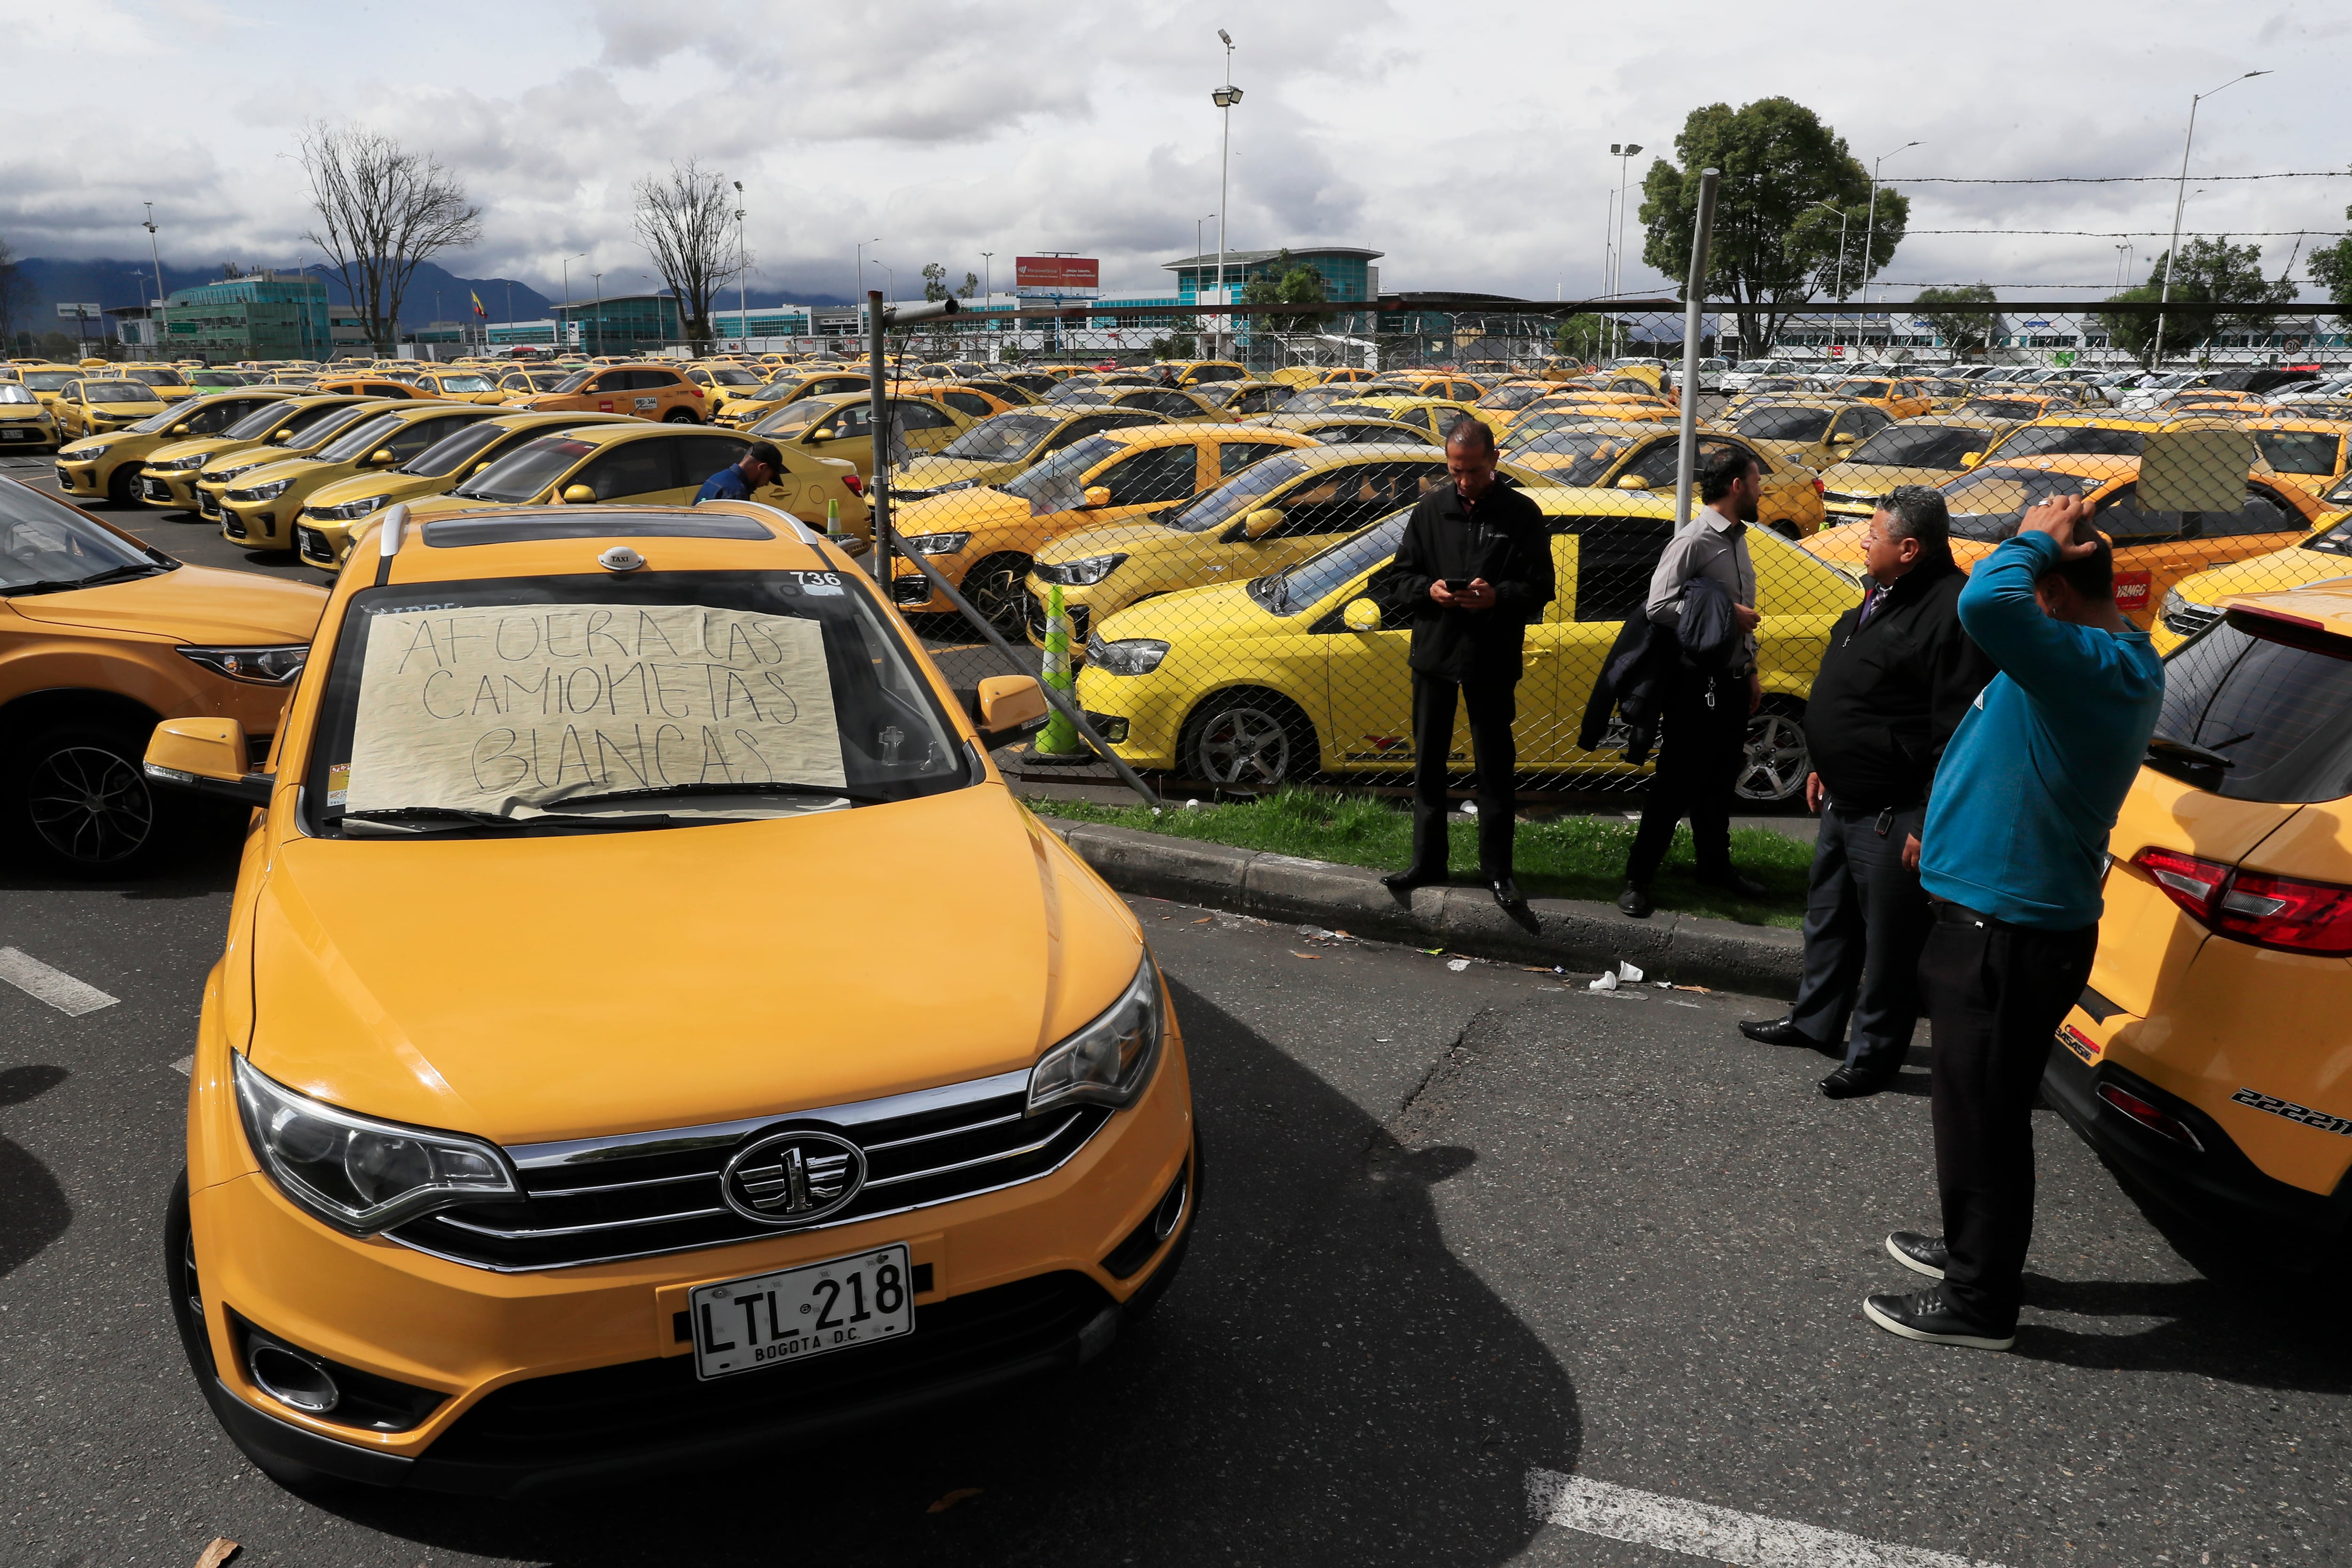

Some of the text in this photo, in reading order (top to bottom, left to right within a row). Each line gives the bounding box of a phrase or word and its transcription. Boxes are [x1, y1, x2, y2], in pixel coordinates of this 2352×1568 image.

[2287, 342, 2298, 350] 30
[790, 571, 842, 586] 736
[2116, 584, 2146, 598] YANGO
[703, 612, 783, 665] LAS
[701, 1264, 904, 1354] LTL 218
[755, 1327, 861, 1362] BOGOTA D.C.
